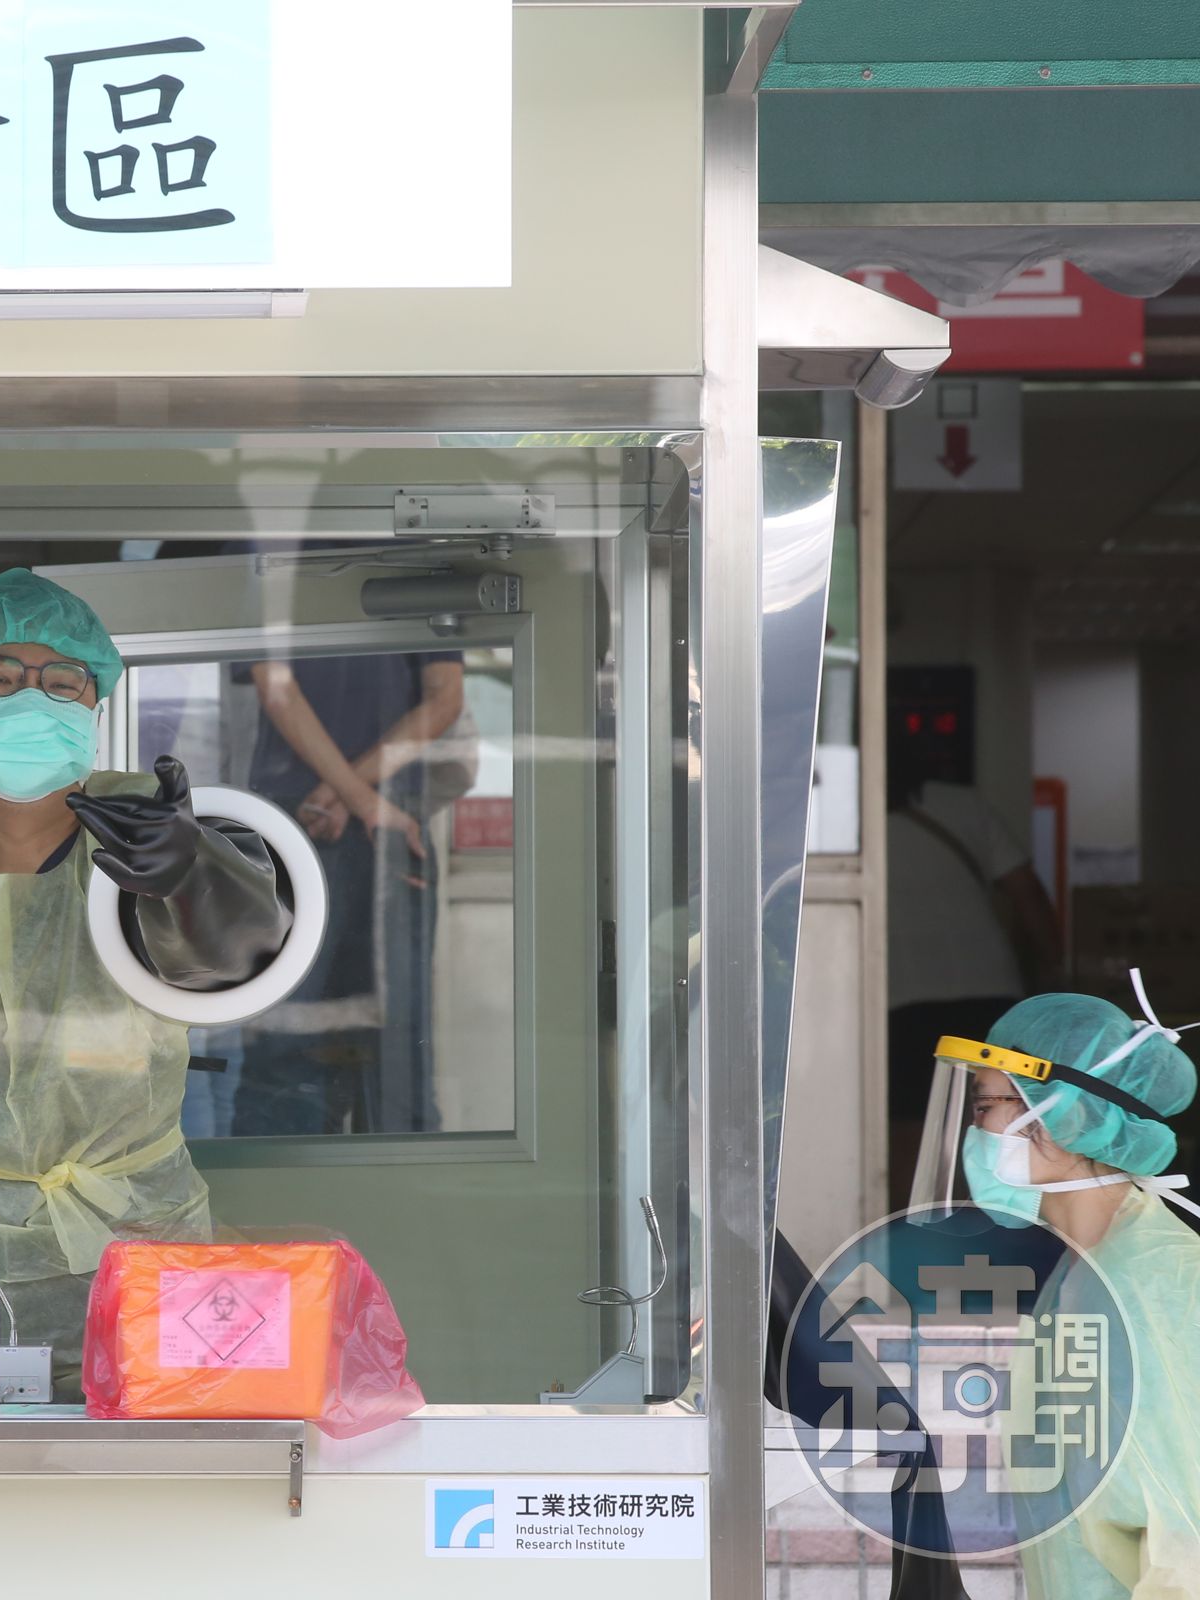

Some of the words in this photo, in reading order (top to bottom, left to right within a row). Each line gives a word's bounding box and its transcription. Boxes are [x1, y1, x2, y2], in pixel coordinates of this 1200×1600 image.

[515, 1493, 695, 1518] 工業技術研究院
[516, 1524, 574, 1535] Industrial
[577, 1524, 645, 1538] Technology
[516, 1539, 572, 1550] Research
[575, 1539, 625, 1550] Institute
